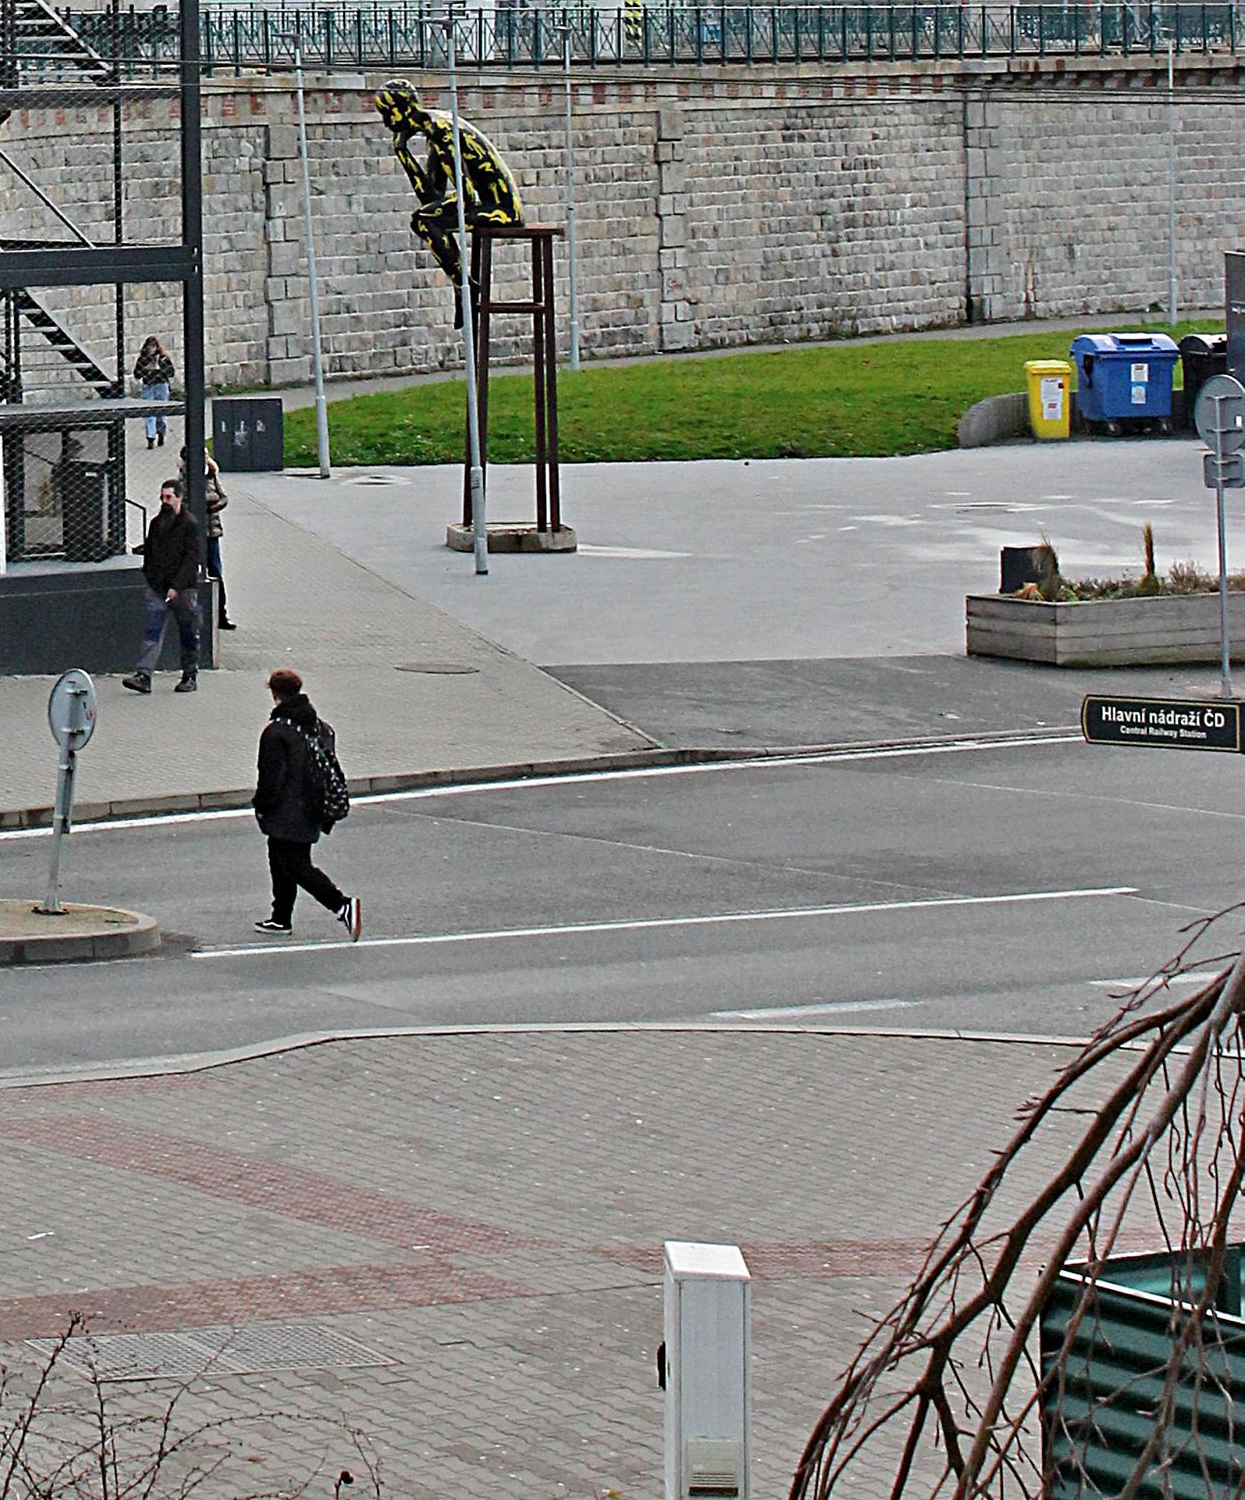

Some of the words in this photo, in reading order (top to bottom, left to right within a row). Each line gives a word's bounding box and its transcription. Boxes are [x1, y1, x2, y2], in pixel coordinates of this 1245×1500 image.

[1101, 706, 1146, 723] Hlavní
[1148, 709, 1201, 727] nádraží
[1203, 708, 1225, 728] ČD
[1120, 725, 1147, 735] Central
[1148, 727, 1179, 739] Railway
[1179, 728, 1207, 739] Station
